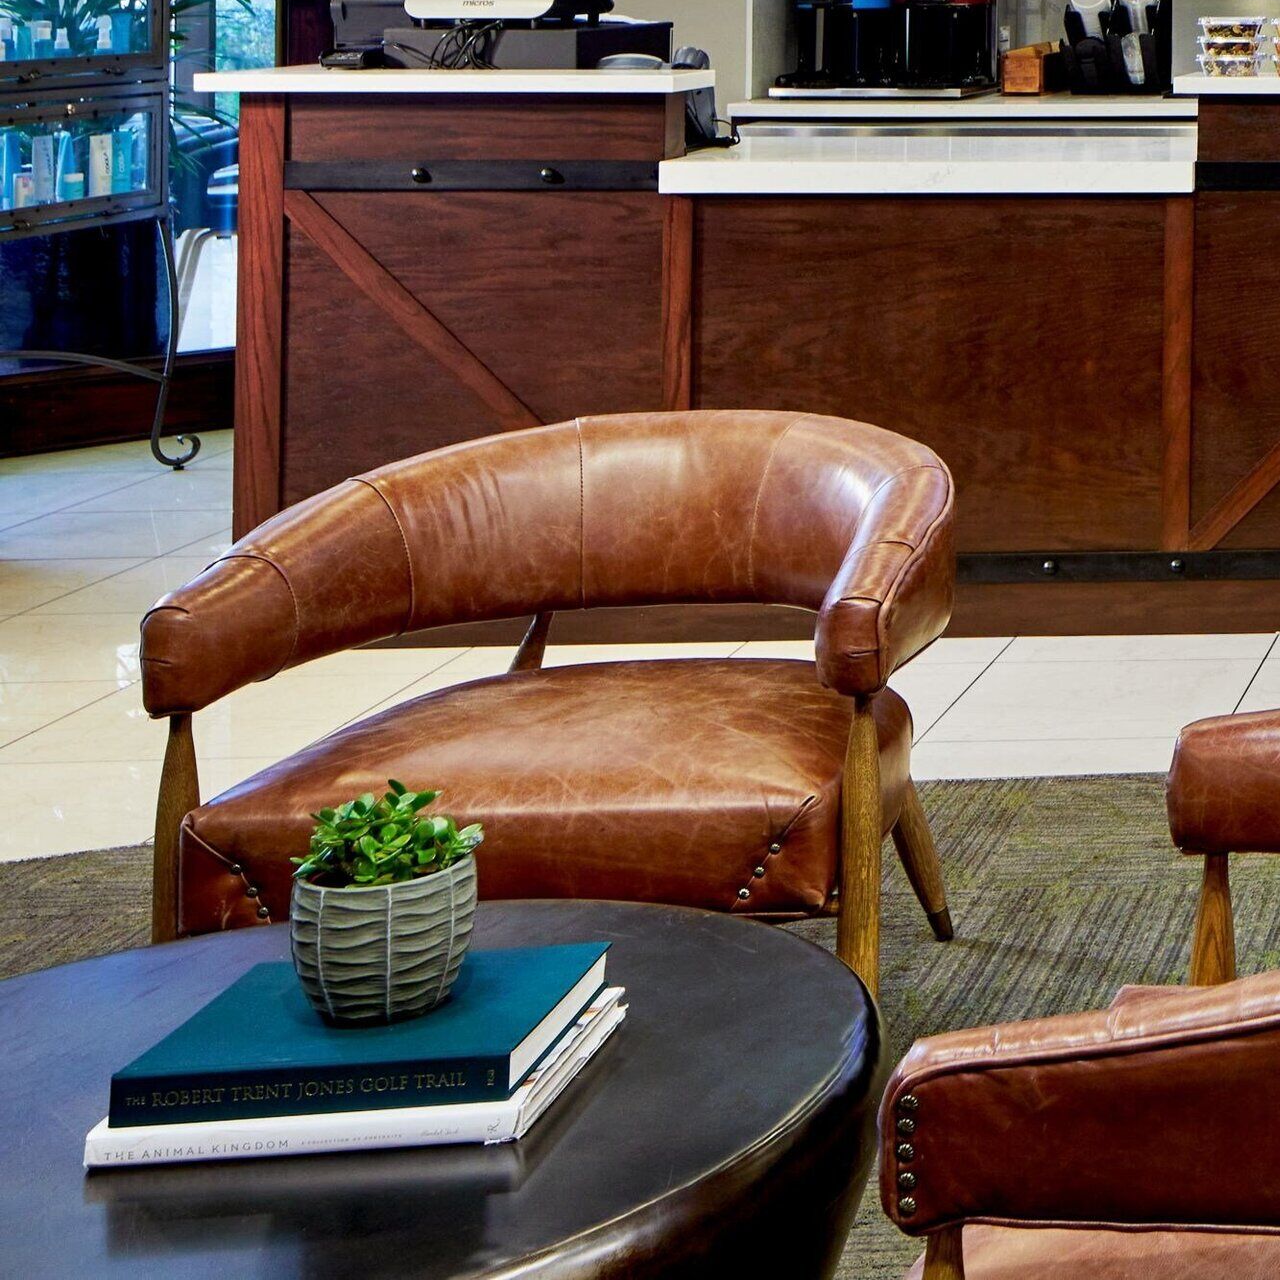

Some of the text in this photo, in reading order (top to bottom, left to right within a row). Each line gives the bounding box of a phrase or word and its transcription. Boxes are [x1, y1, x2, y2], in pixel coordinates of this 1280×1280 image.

[462, 0, 495, 7] micros
[126, 1096, 145, 1106] THE
[152, 1088, 226, 1107] ROBERT
[231, 1083, 293, 1102] TRENT
[297, 1079, 354, 1101] JONES
[360, 1075, 410, 1093] GOLF
[414, 1072, 467, 1090] TRAIL
[104, 1140, 289, 1161] THE ANIMAL KINGDOM
